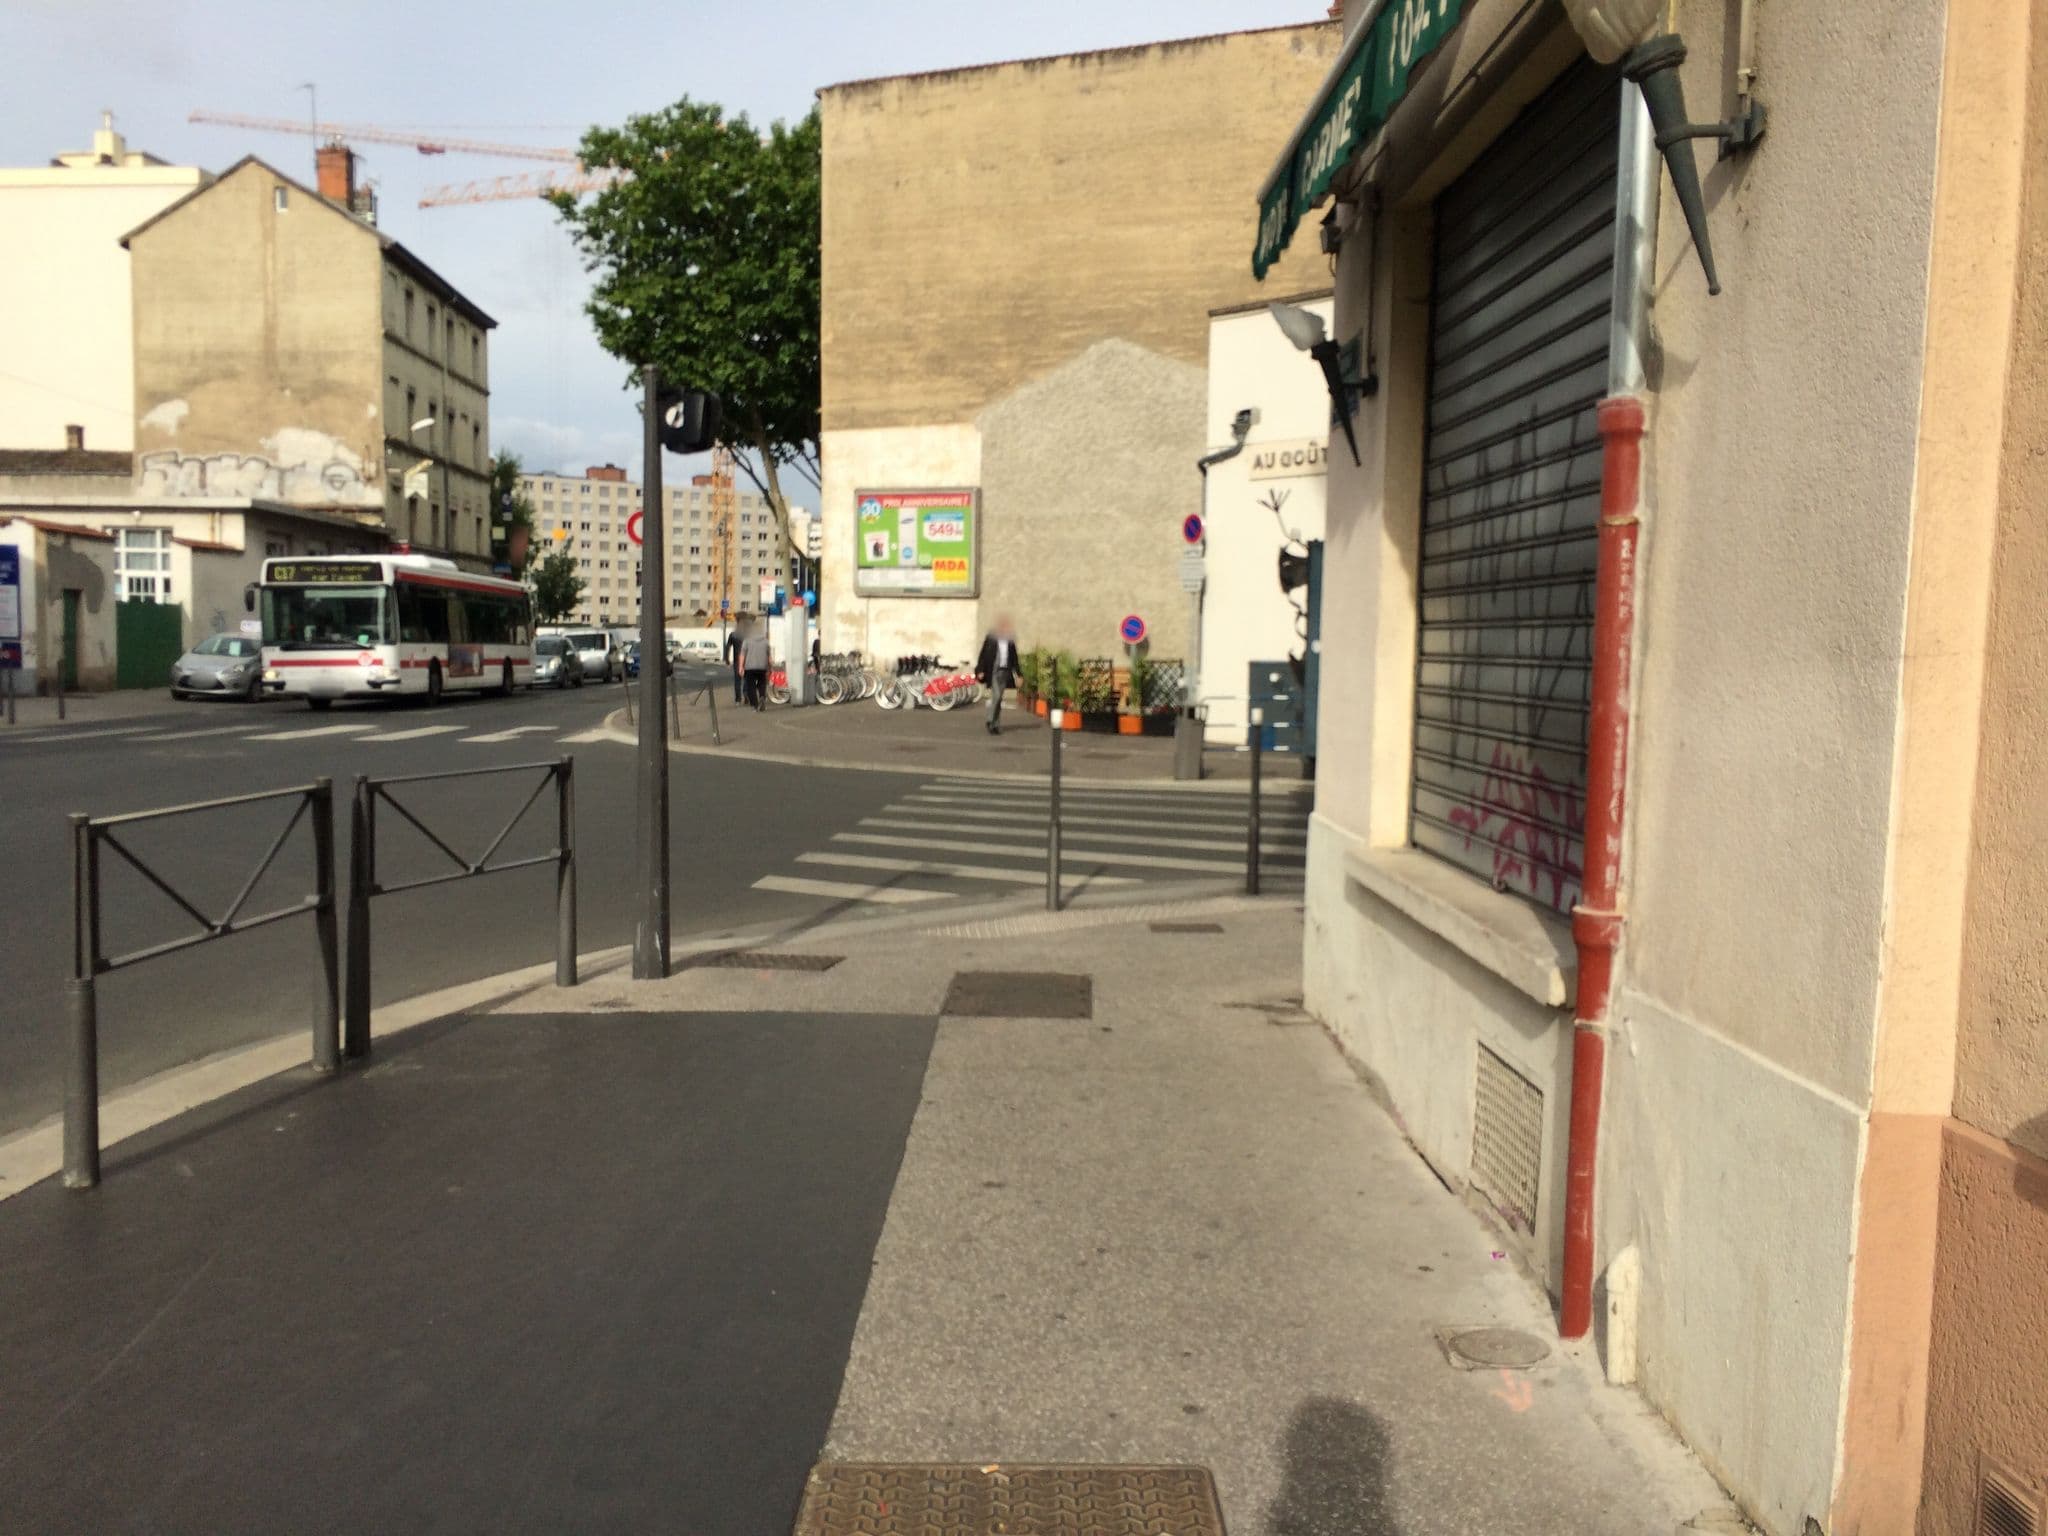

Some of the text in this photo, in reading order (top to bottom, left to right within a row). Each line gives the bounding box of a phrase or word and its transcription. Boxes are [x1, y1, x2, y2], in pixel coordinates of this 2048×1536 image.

[1253, 452, 1275, 470] AU
[928, 523, 953, 537] 549
[934, 560, 966, 571] MDA
